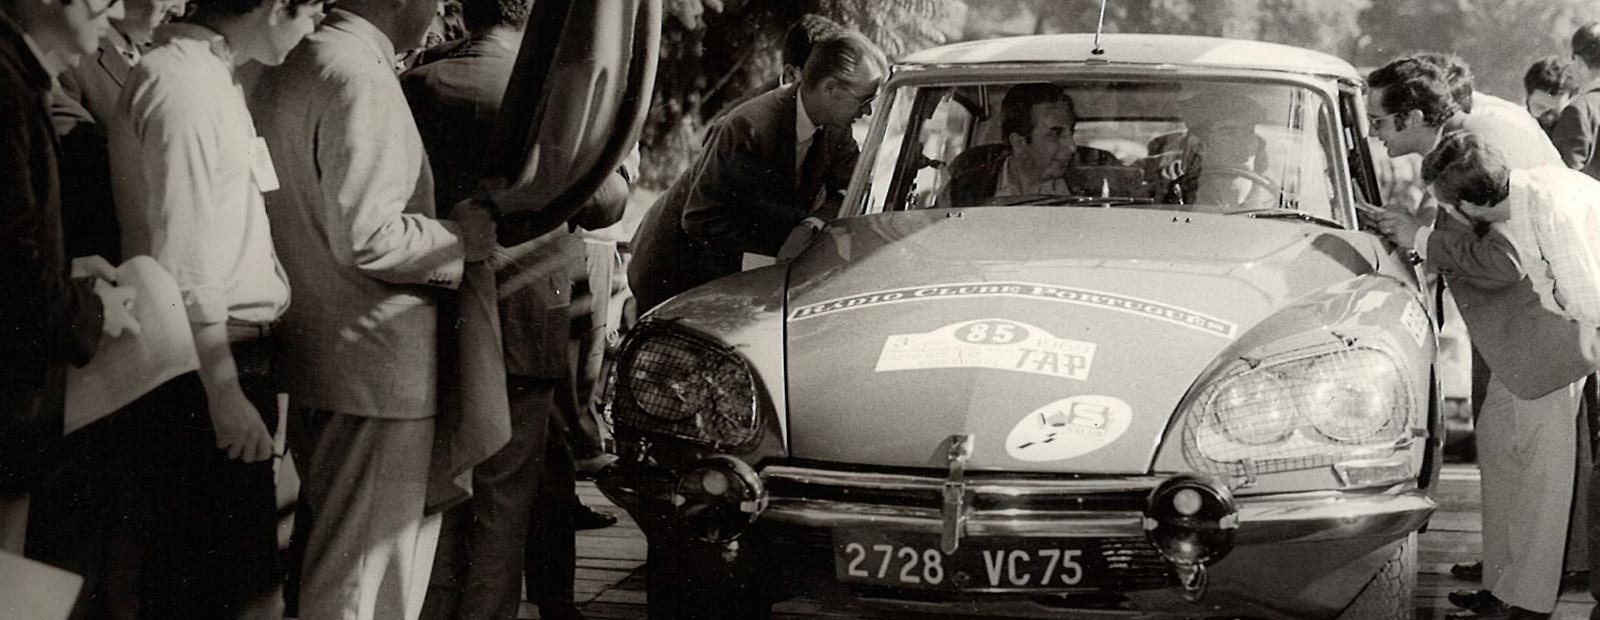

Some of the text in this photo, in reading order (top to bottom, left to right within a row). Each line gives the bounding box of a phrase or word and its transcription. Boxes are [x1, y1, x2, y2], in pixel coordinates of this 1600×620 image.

[966, 323, 1016, 343] 85
[1015, 348, 1086, 376] TAP
[846, 542, 944, 585] 2728
